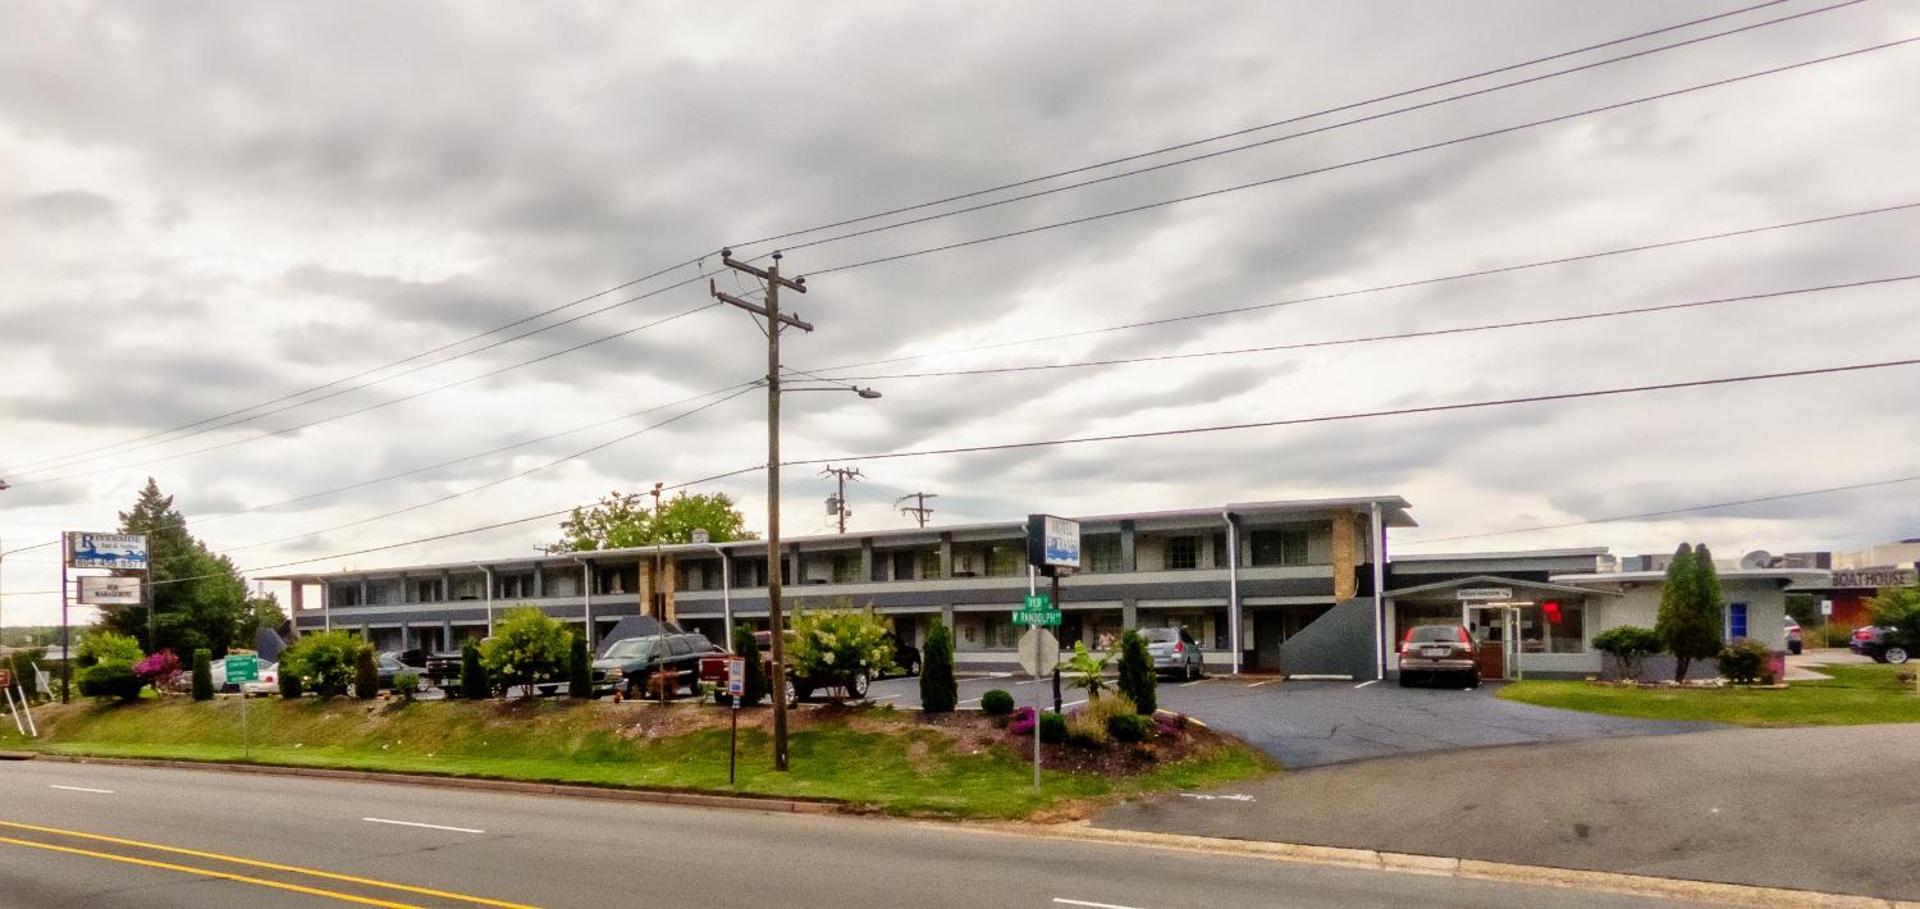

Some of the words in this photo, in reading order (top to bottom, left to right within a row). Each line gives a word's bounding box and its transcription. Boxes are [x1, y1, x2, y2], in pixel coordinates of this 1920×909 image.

[82, 534, 140, 549] RIVERSIDE
[1832, 572, 1905, 587] BOATHOUSE
[1021, 612, 1056, 624] RANDOLPH
